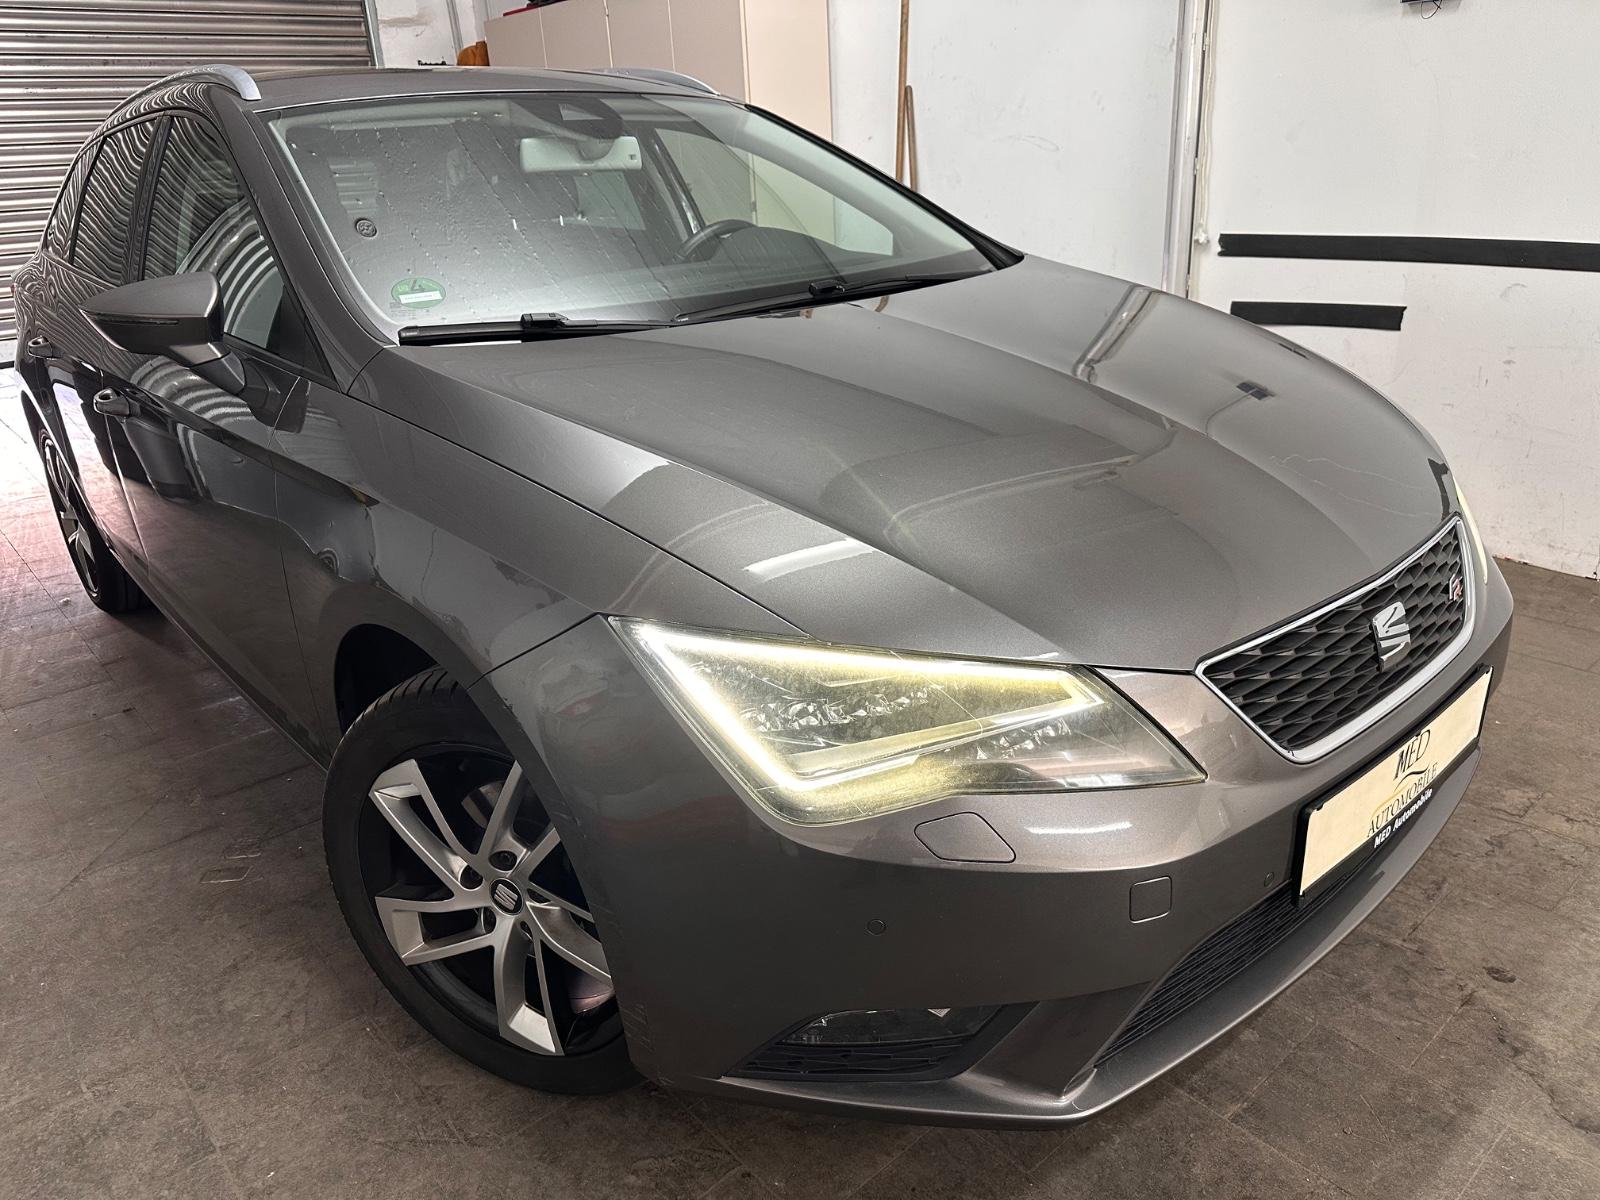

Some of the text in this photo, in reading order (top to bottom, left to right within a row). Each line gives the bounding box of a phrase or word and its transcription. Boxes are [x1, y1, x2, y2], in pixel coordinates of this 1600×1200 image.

[1393, 729, 1431, 781] MED
[1367, 761, 1439, 838] AUTOMOBILE
[1373, 788, 1433, 849] MED Automobile
